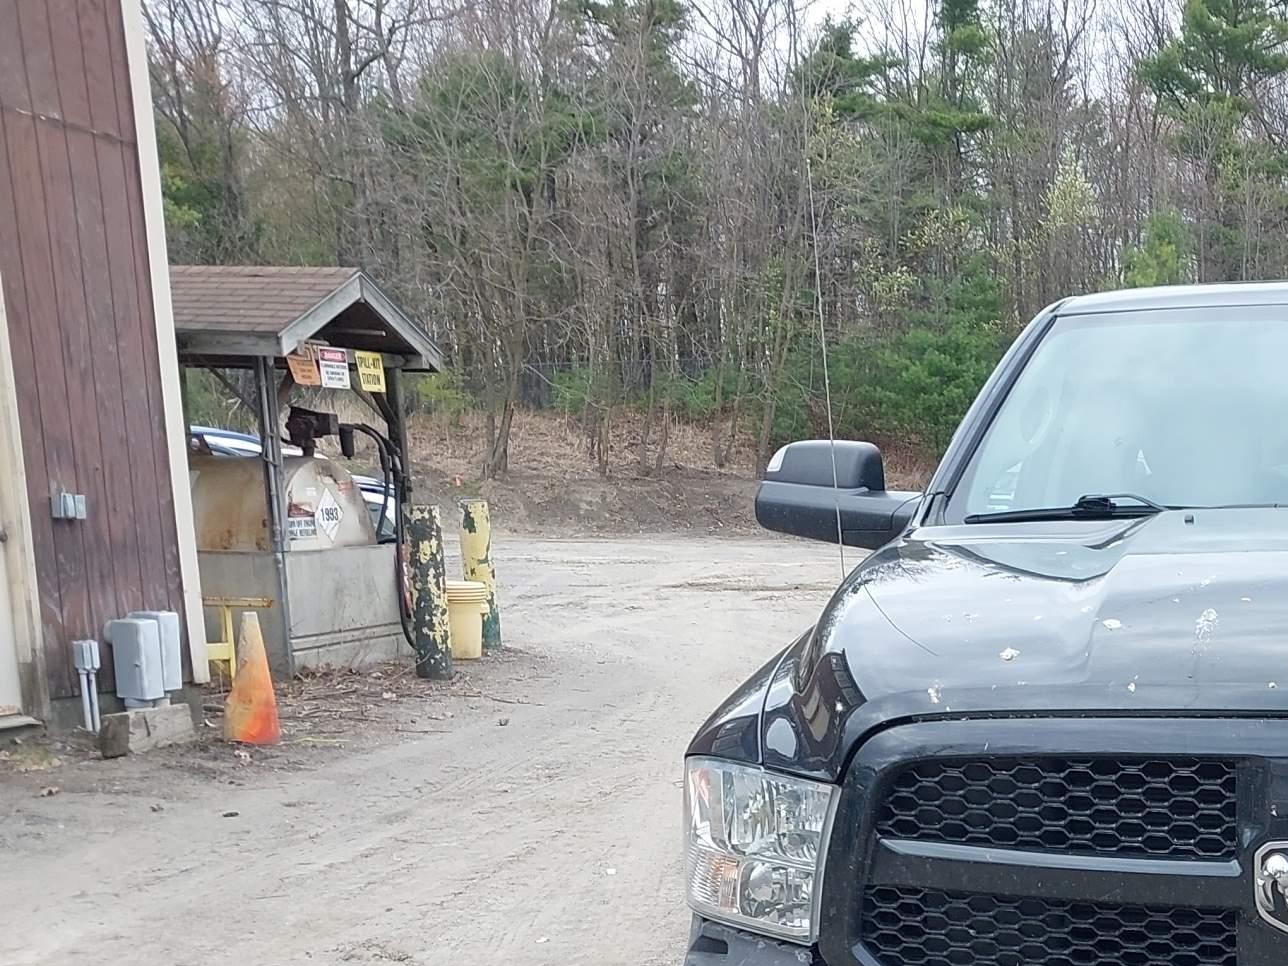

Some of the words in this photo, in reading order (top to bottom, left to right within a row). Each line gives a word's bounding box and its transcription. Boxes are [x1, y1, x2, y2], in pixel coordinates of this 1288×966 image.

[357, 356, 381, 370] SPILL-KIT
[361, 373, 381, 386] STATION
[321, 507, 339, 521] 1993
